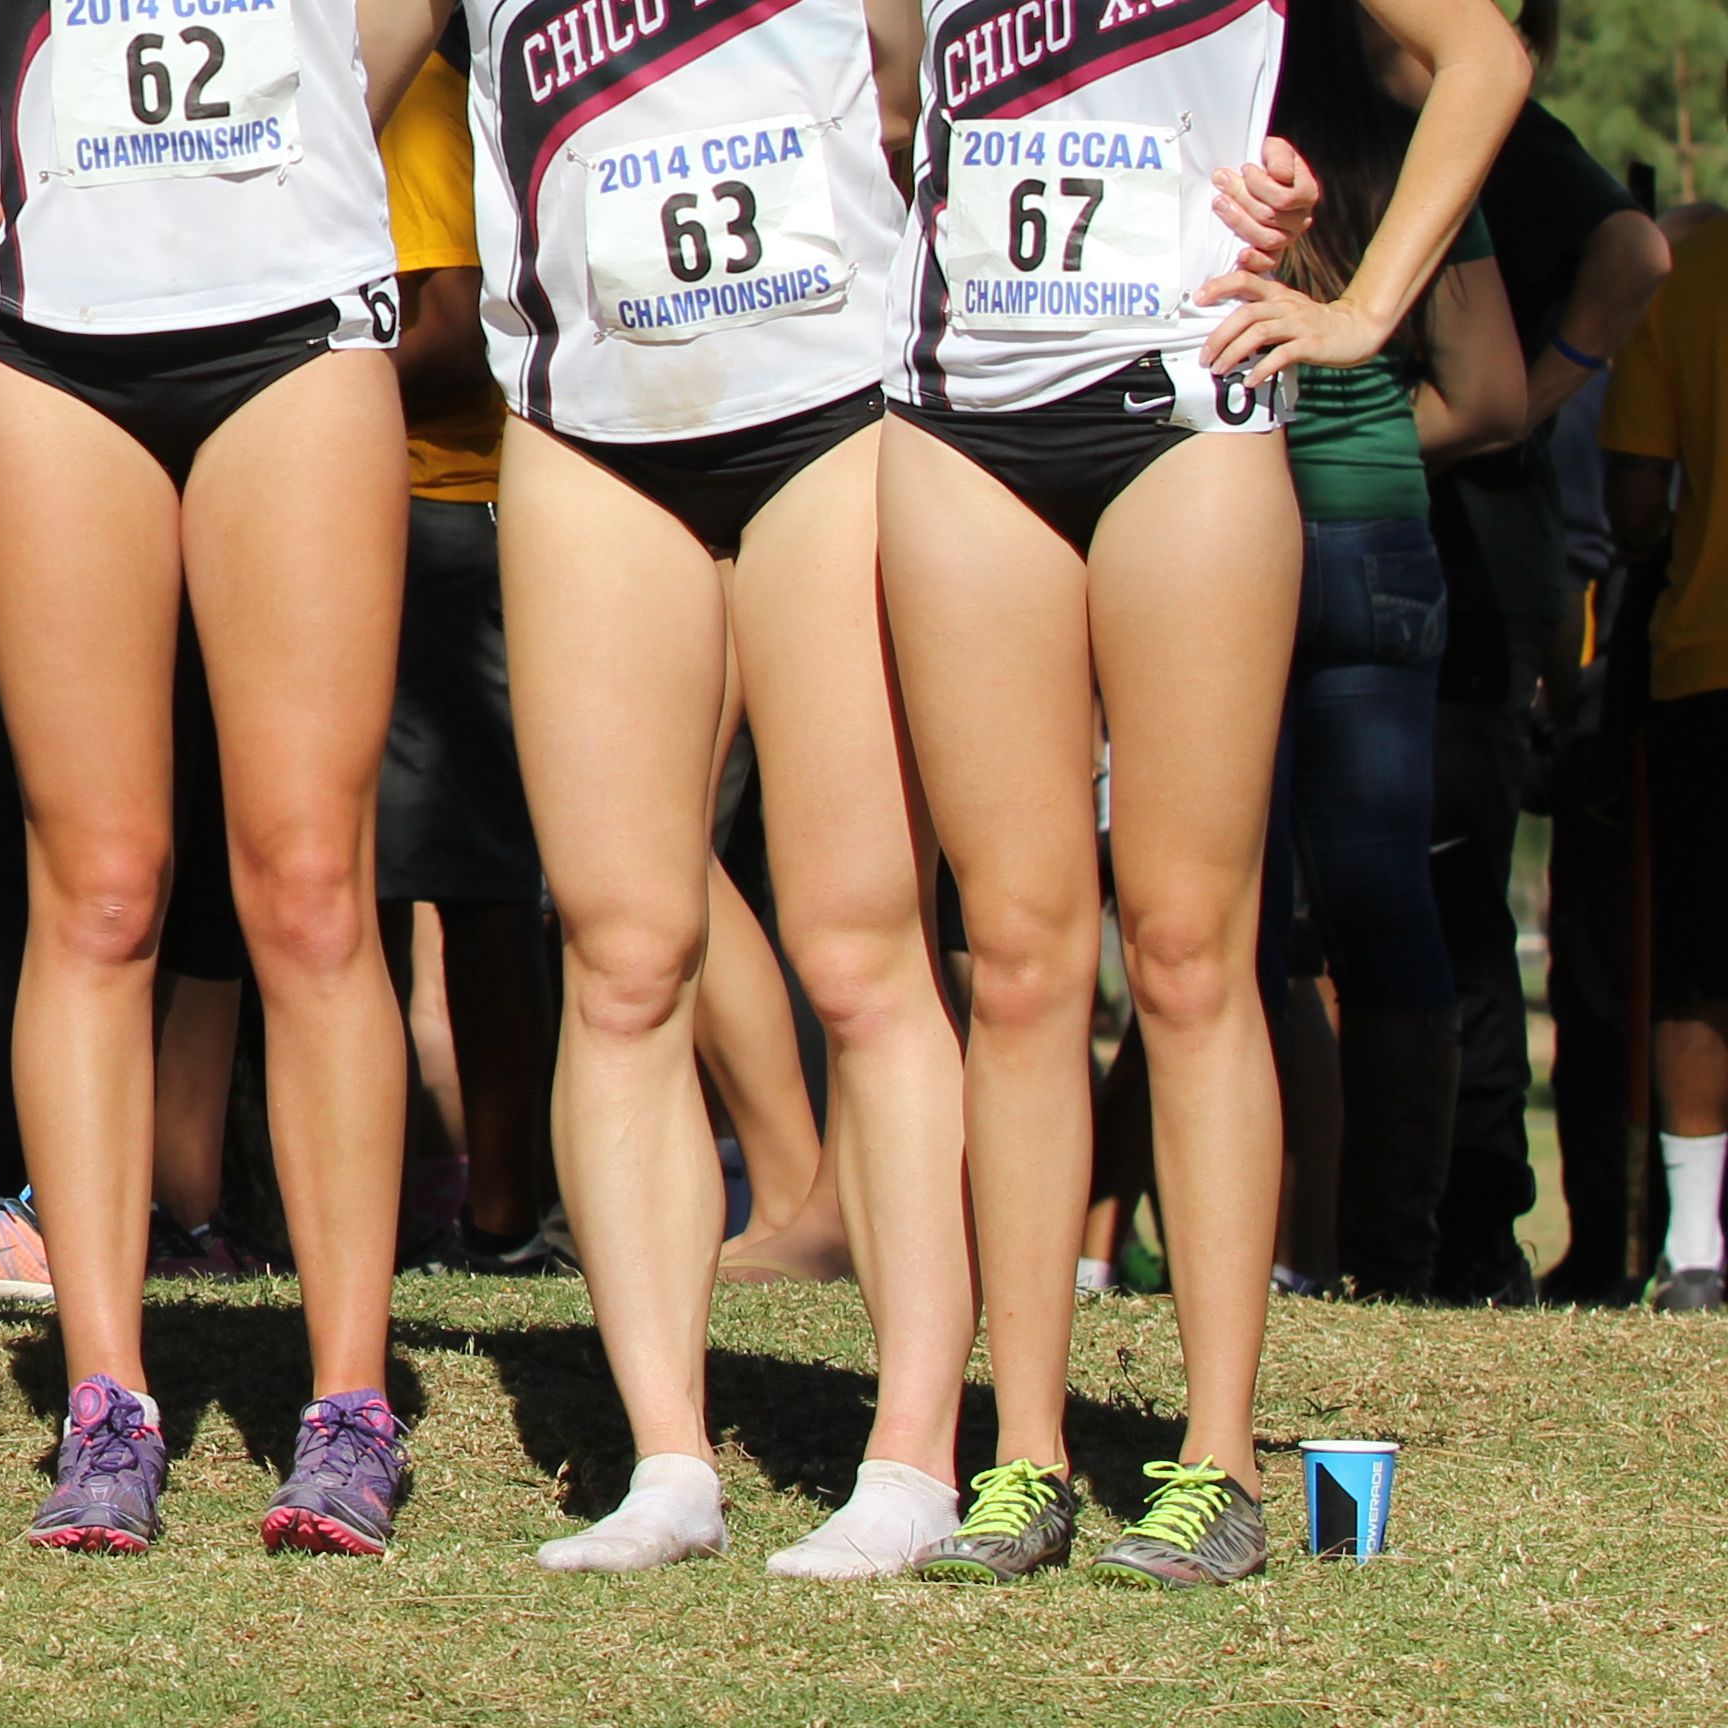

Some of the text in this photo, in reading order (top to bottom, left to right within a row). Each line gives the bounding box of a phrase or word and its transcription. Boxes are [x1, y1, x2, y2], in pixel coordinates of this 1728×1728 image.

[126, 26, 231, 125] 62
[76, 117, 281, 172] CHAMPIONSHIPS
[598, 125, 803, 193] 2014 CCAA
[963, 132, 1162, 170] 2014 CCAA
[661, 180, 761, 283] 63
[1008, 178, 1104, 272] 67
[619, 264, 830, 329] CHAMPIONSHIPS
[965, 281, 1161, 317] CHAMPIONSHIPS
[1364, 1461, 1384, 1555] OWERADE
